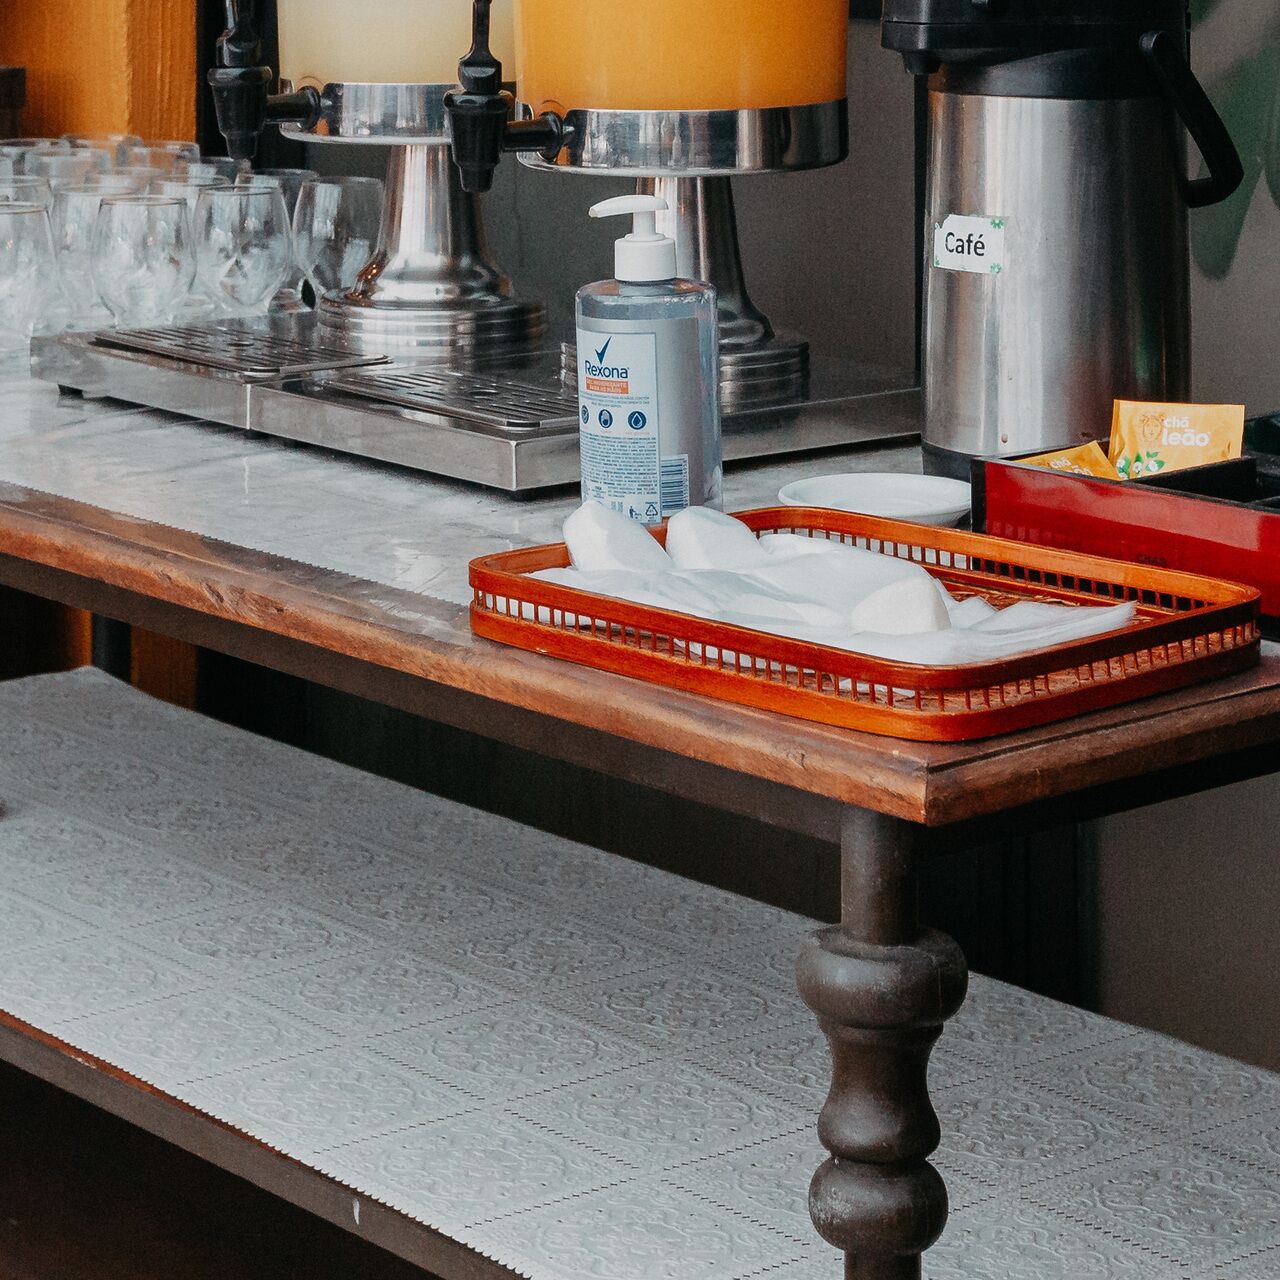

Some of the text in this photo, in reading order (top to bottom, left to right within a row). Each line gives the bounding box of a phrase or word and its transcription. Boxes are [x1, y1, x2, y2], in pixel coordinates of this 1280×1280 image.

[945, 231, 985, 257] Café
[584, 360, 629, 379] Rexona
[1164, 416, 1190, 429] chá
[1162, 429, 1210, 448] leão
